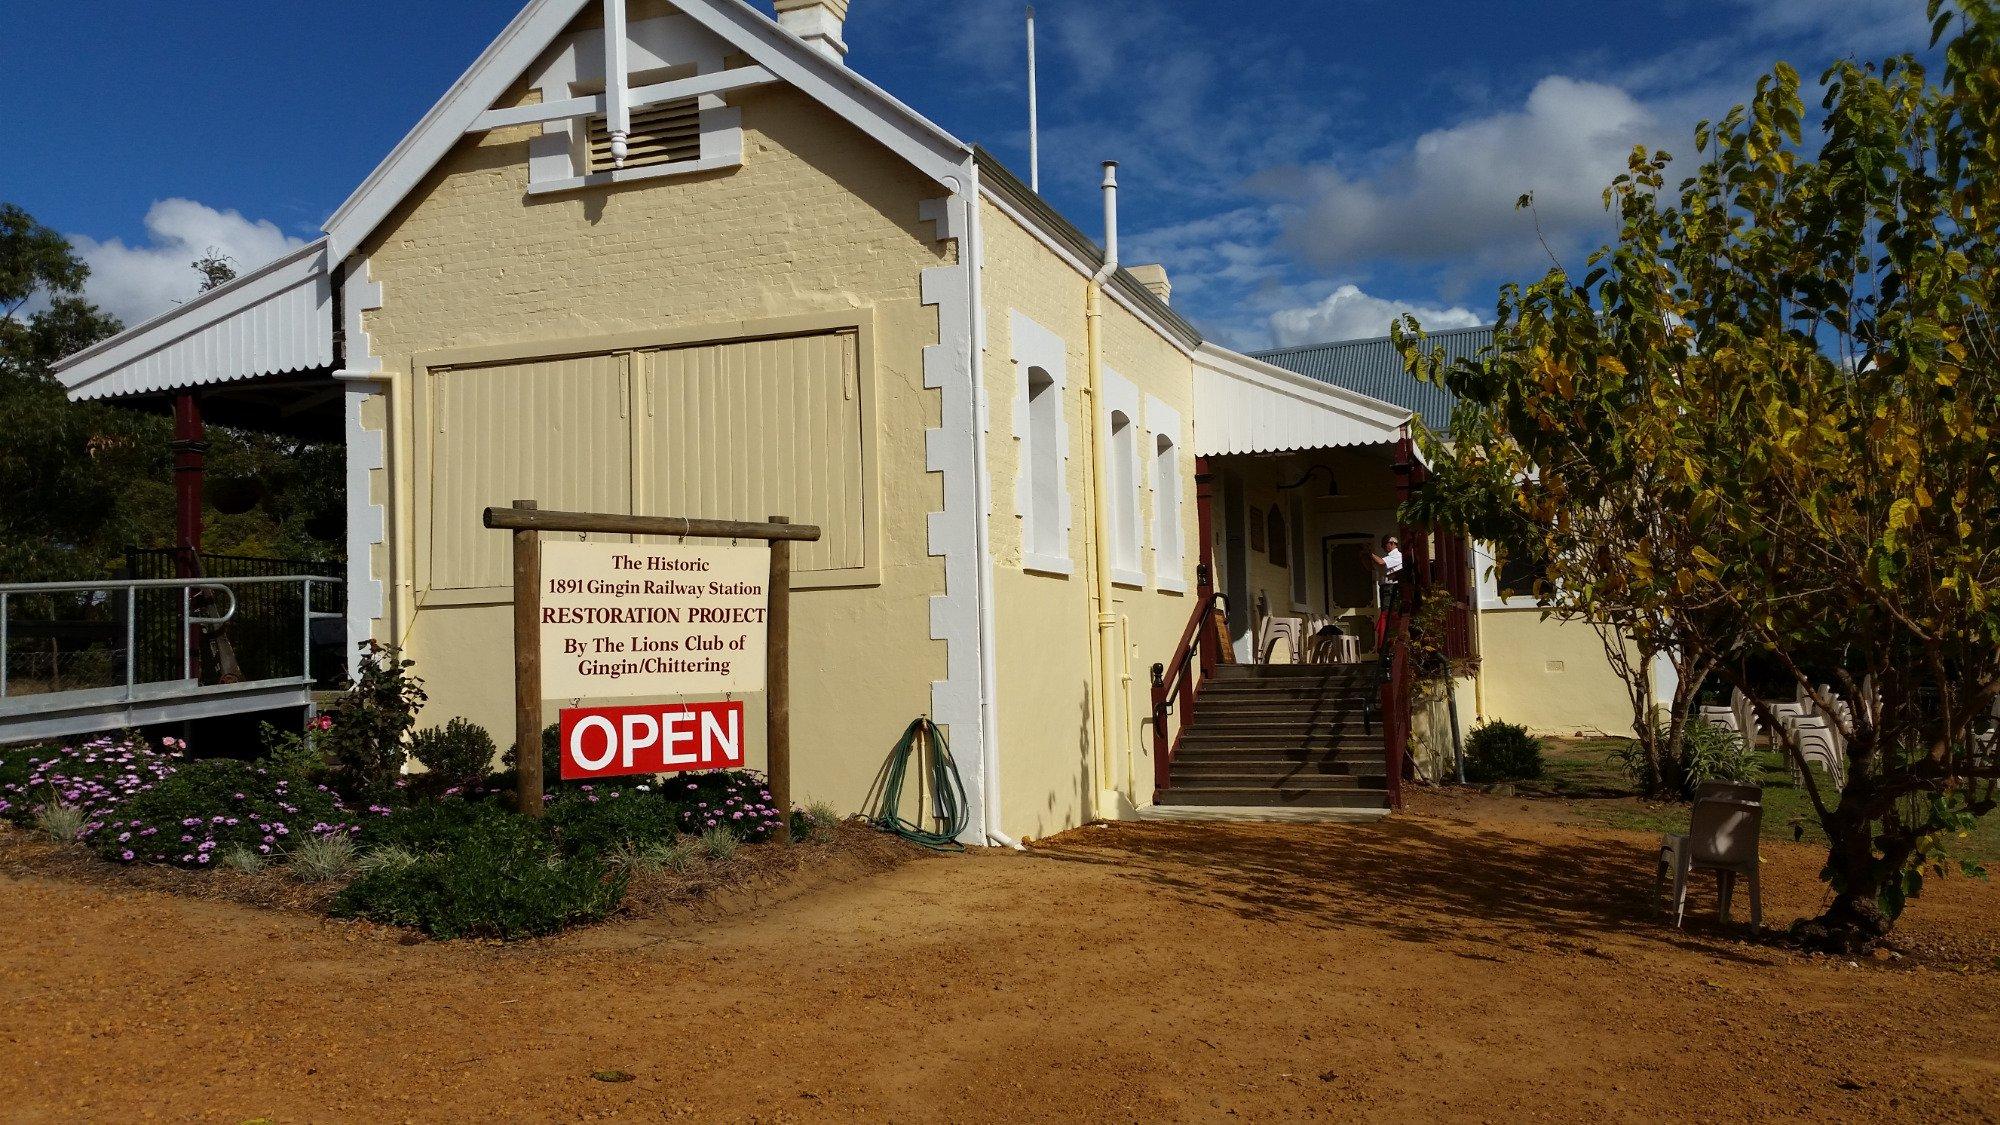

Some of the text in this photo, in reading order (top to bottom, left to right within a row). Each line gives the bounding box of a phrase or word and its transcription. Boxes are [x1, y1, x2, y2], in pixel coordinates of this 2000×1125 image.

[612, 555, 710, 572] The Historic
[549, 578, 762, 598] 1891 Gingin Railway Station
[541, 606, 767, 624] RESTORATION PROJECT
[564, 634, 747, 657] By The Lions Club of
[578, 656, 731, 678] Gingin/Chittering
[570, 709, 739, 771] OPEN
